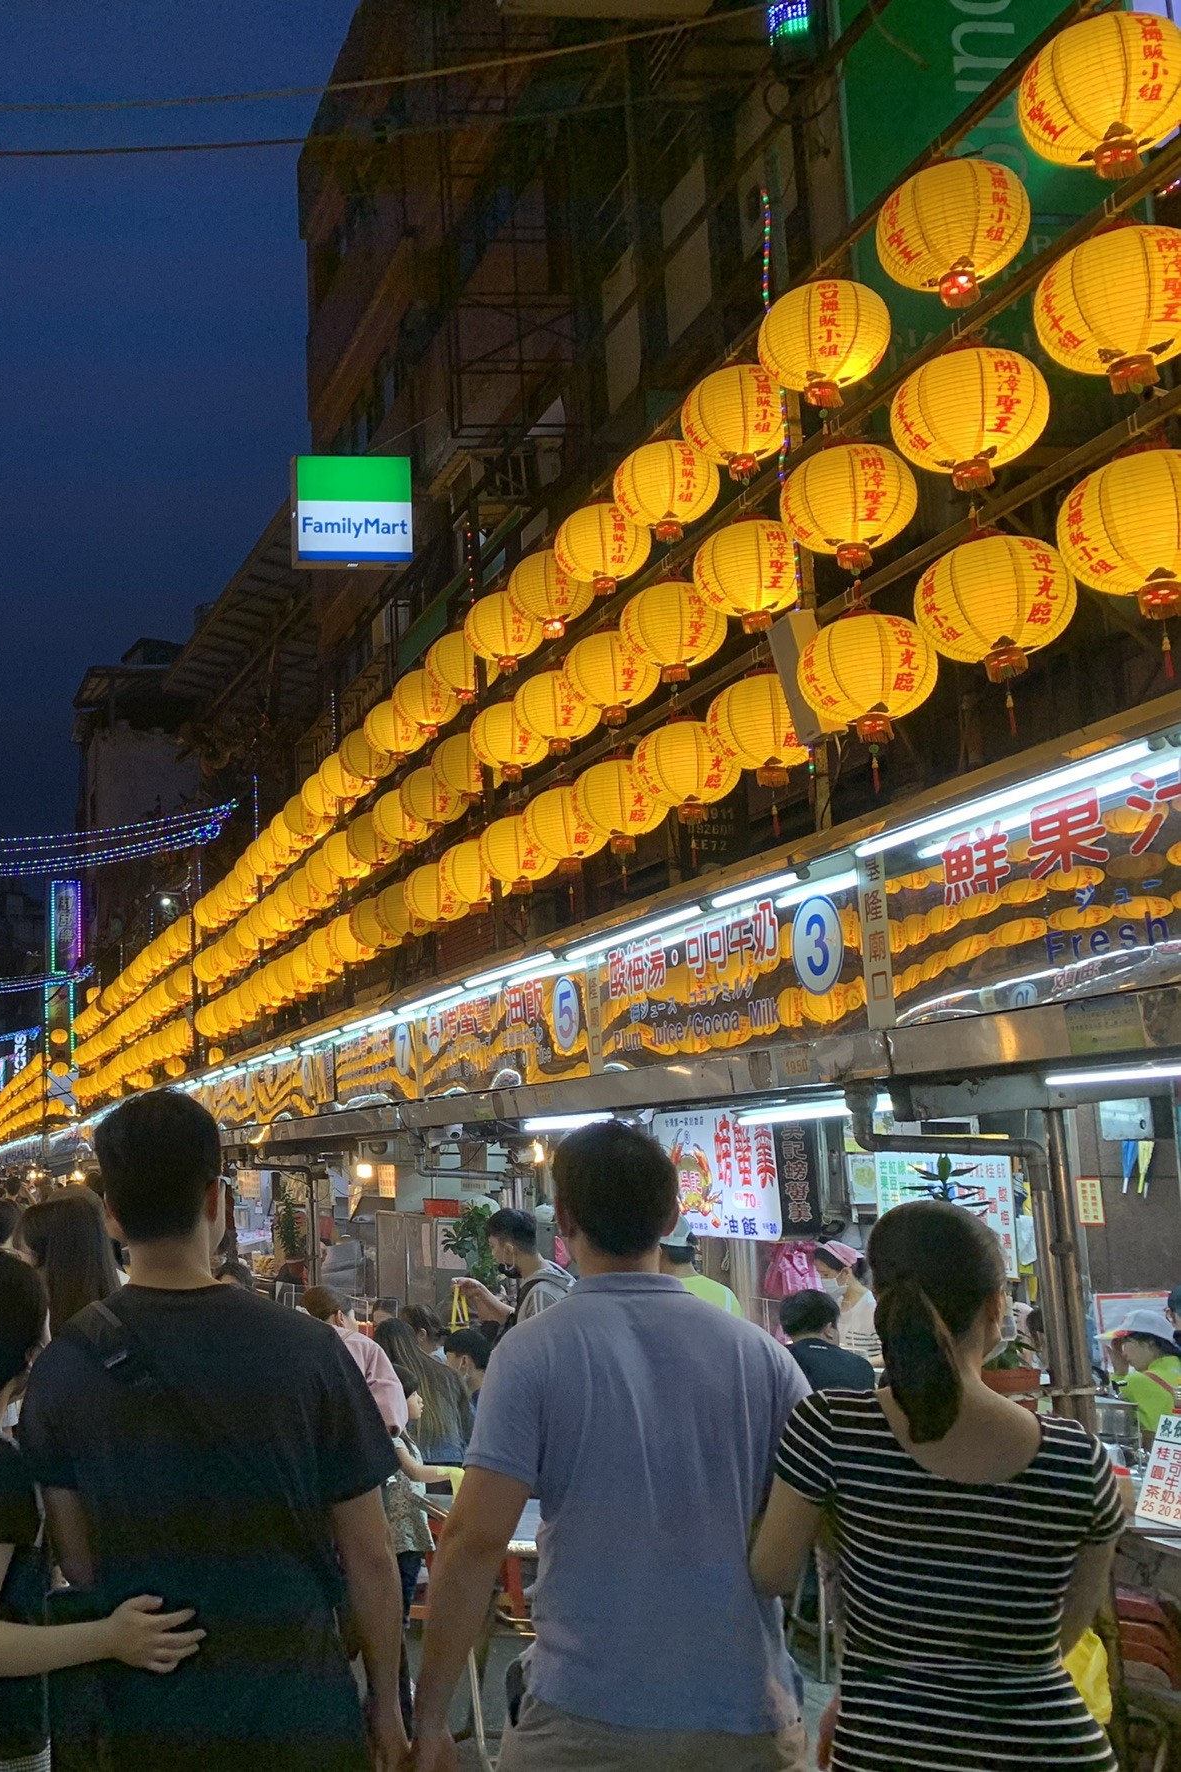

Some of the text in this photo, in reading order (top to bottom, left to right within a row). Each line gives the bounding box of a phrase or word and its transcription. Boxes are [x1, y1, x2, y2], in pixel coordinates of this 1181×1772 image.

[987, 360, 1022, 434] 開漳聖王
[859, 457, 888, 523] 開漳聖王
[301, 516, 409, 539] FamilyMart
[764, 530, 790, 590] 開漳聖王
[805, 913, 831, 978] 3
[1045, 911, 1170, 966] Fresh
[558, 989, 574, 1039] 5
[613, 996, 780, 1054] Plum Juice/Cocoa Milk
[724, 1215, 759, 1236] 油飯
[742, 1192, 757, 1208] 70
[1145, 1446, 1171, 1501] 桂圓茶
[1159, 1448, 1181, 1506] 可可牛奶
[1141, 1500, 1155, 1514] 25
[1157, 1503, 1172, 1518] 20
